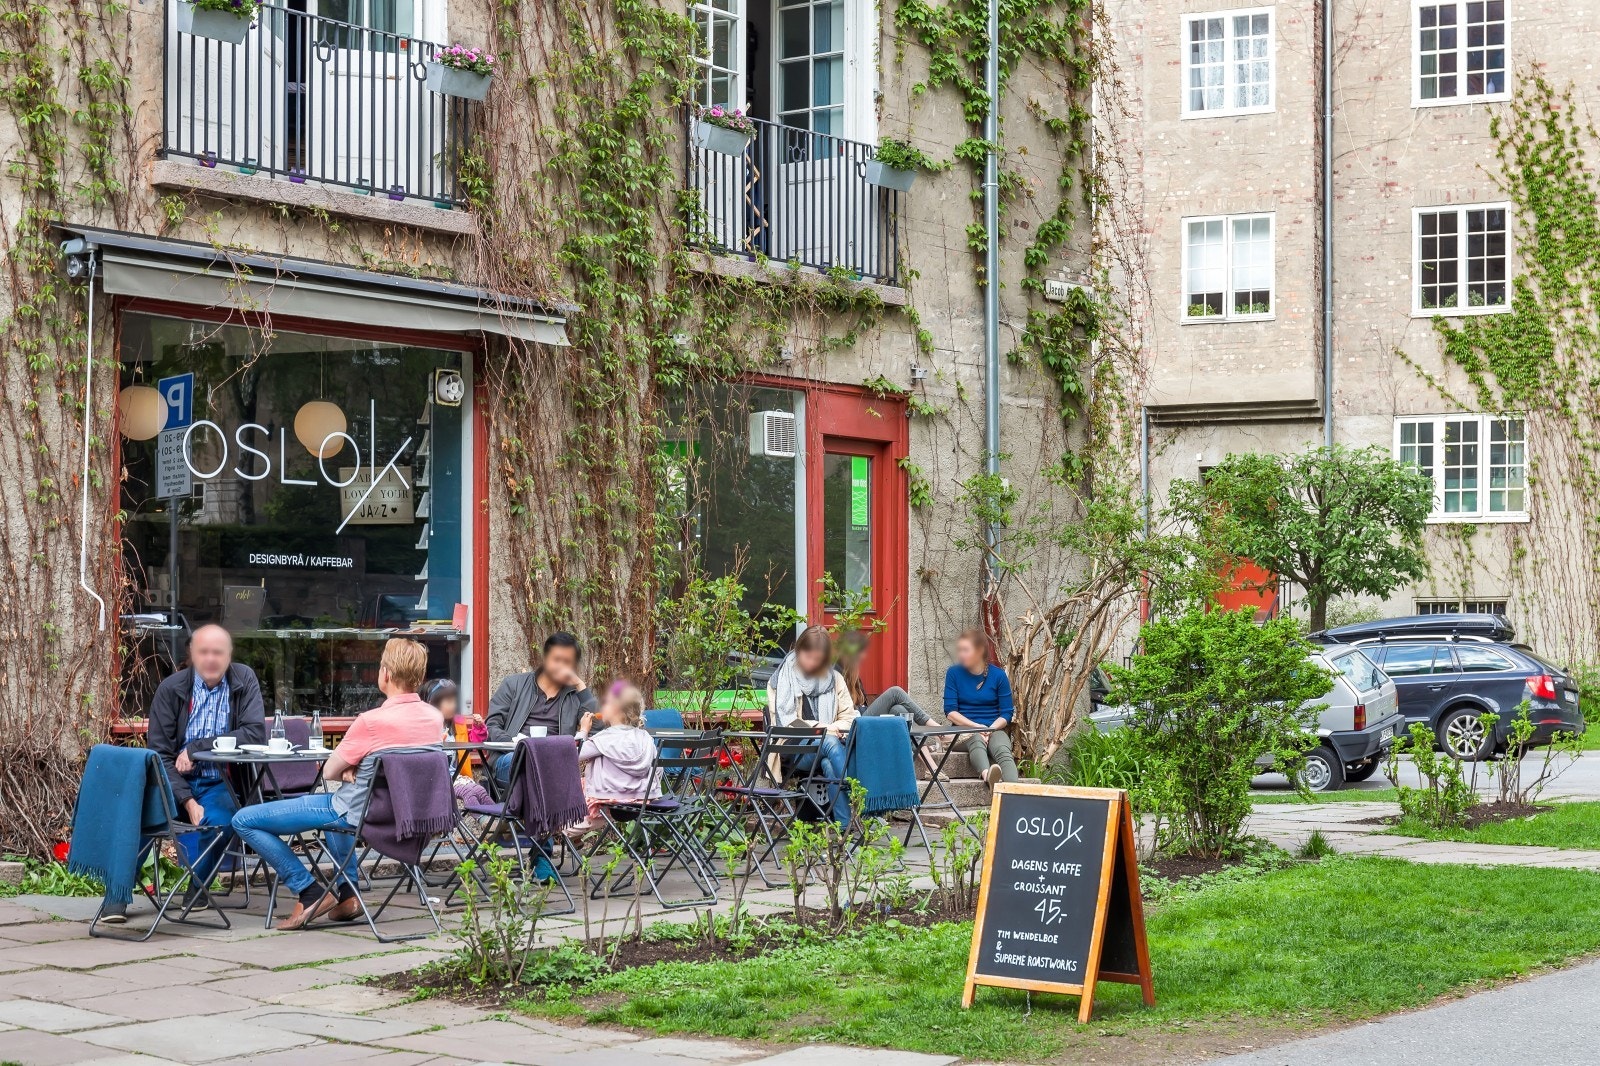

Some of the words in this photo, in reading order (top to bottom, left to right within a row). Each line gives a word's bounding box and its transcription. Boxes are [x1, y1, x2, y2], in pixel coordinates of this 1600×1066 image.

[1049, 283, 1064, 297] Jacob
[249, 553, 304, 566] DESIGNBYRÅ
[310, 556, 353, 568] KAFFEBAR
[1011, 859, 1049, 872] DAGENS
[1052, 862, 1082, 877] KAFFE
[1013, 881, 1067, 896] CROISSANT
[997, 929, 1011, 940] TIM
[1013, 931, 1059, 944] WENDELBOE
[995, 941, 1003, 950] &
[993, 952, 1026, 966] SUPREME
